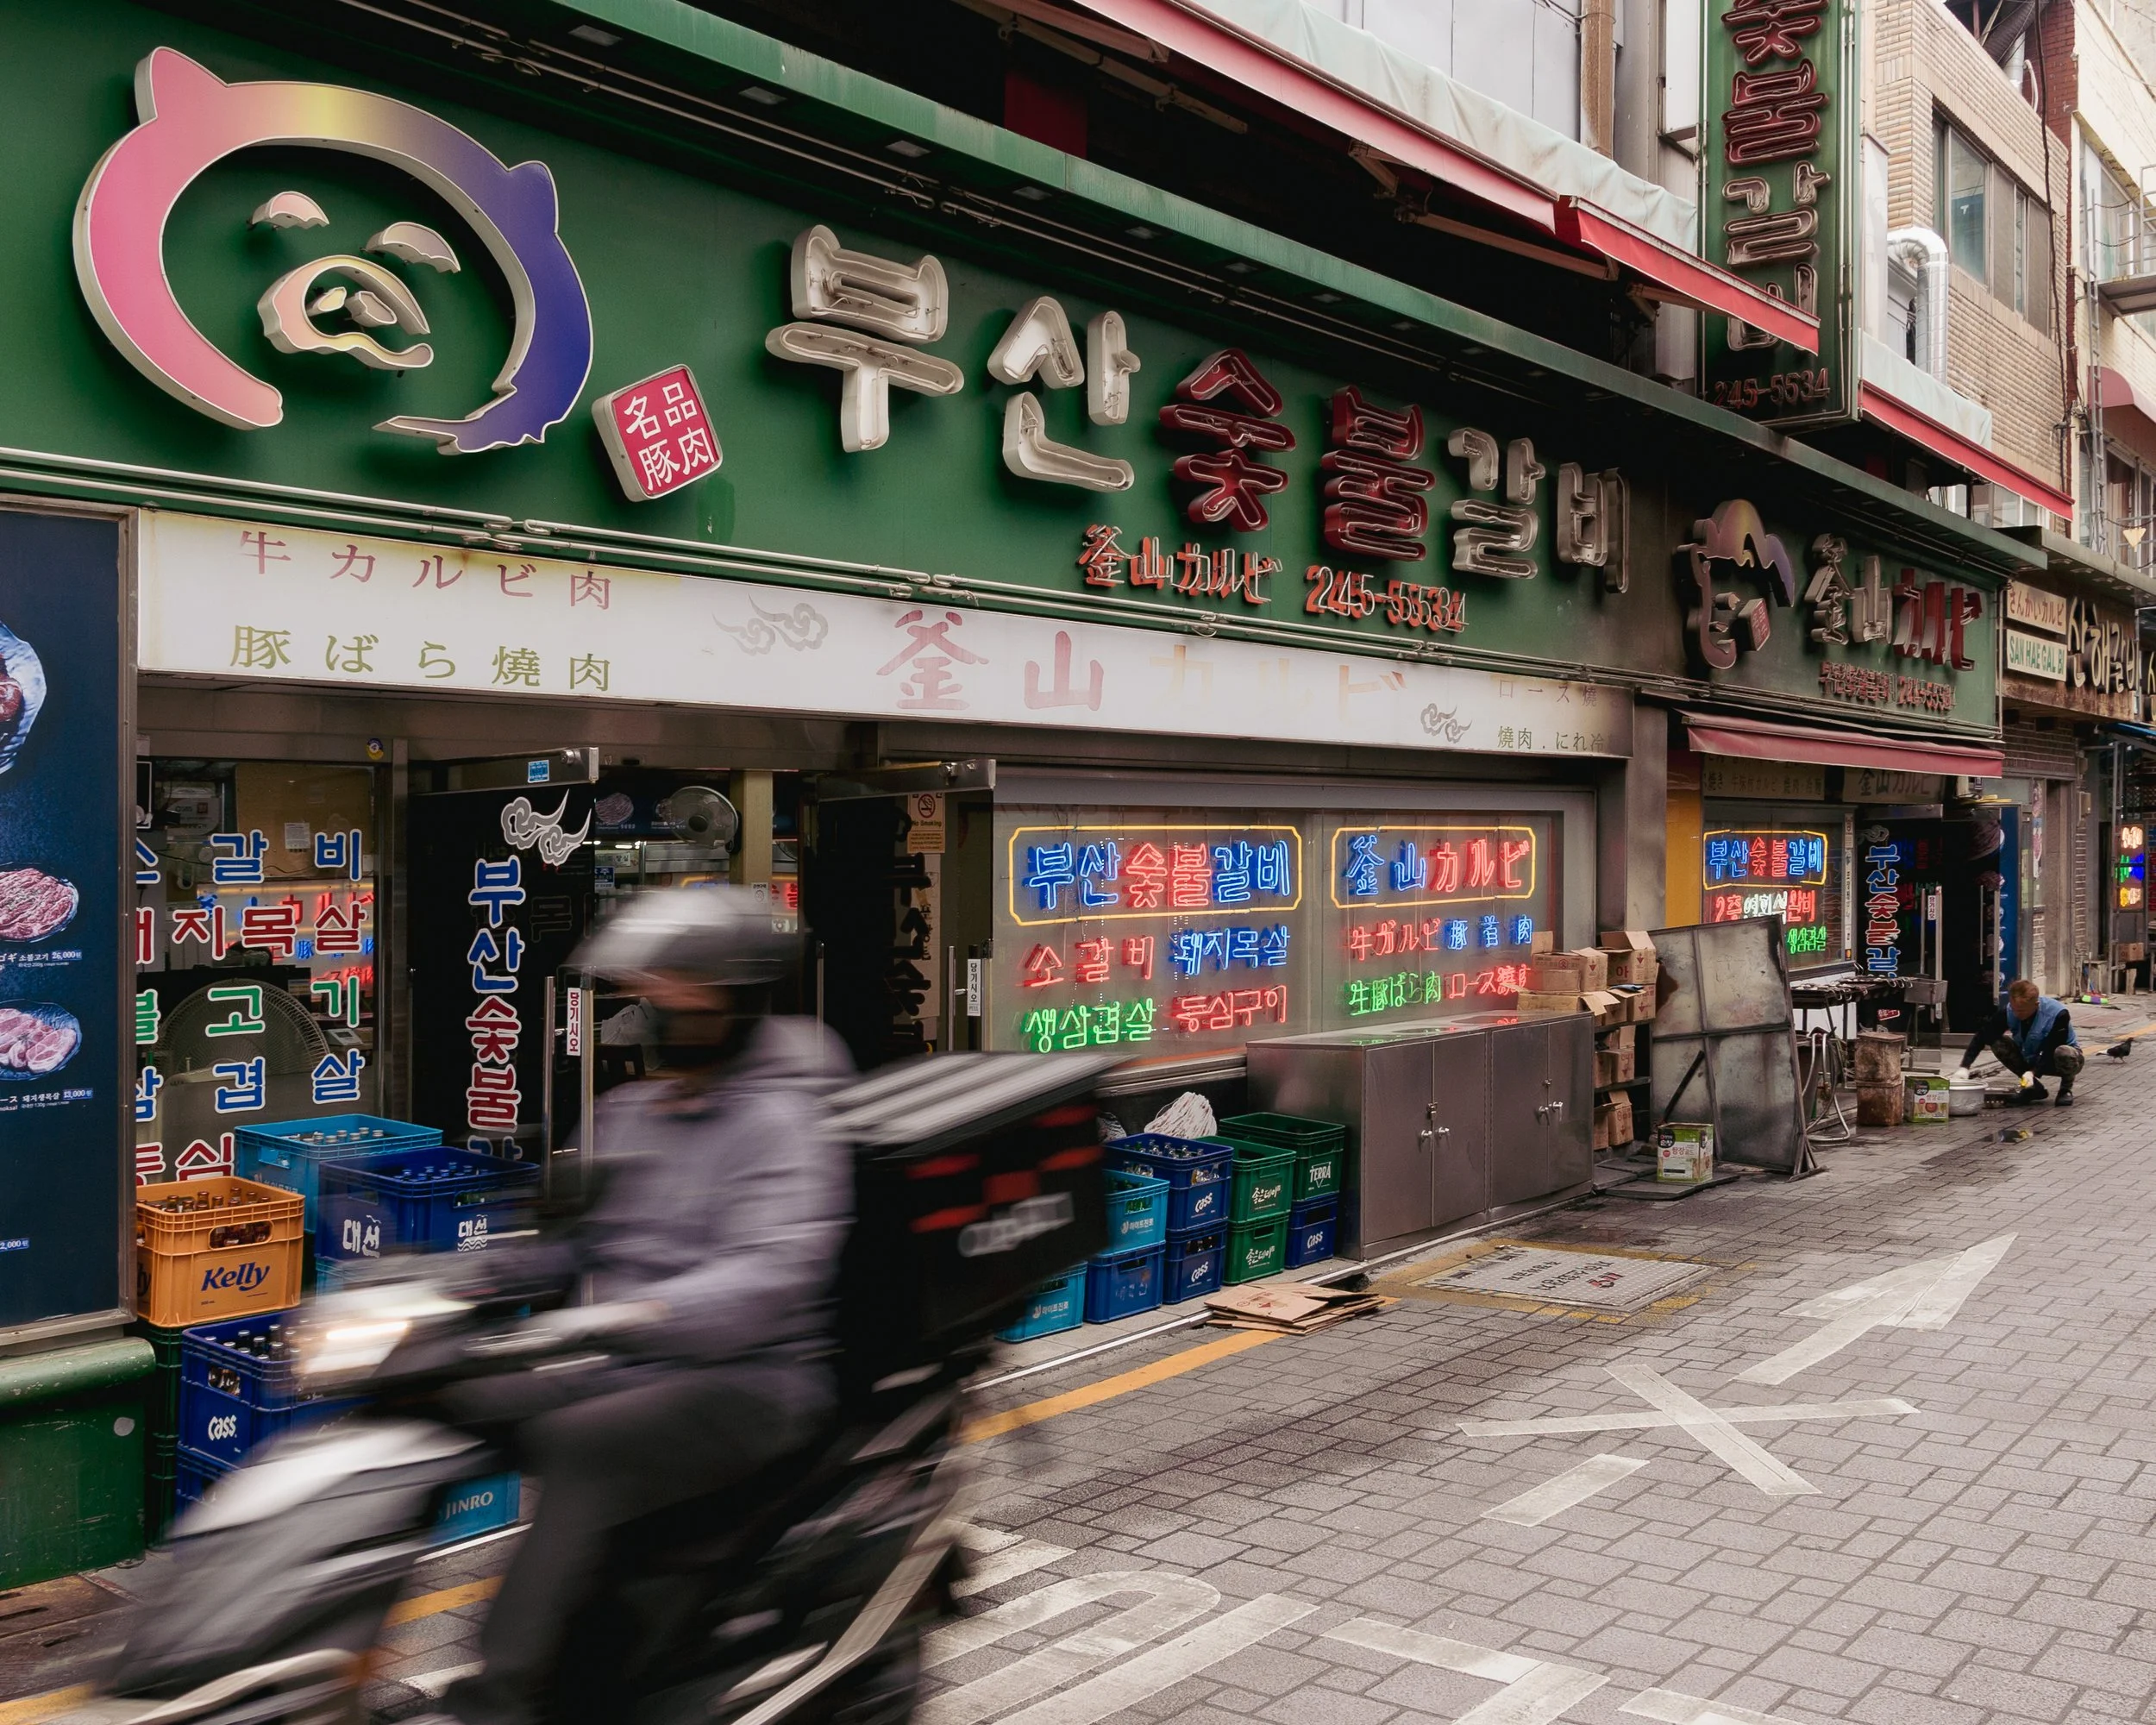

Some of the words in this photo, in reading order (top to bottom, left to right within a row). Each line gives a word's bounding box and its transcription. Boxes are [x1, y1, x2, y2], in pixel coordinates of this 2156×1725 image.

[624, 381, 699, 440] 名品
[766, 224, 1630, 594] 부산숯불갈비
[1714, 367, 1832, 409] 245-5534
[639, 427, 716, 492] 豚肉
[239, 530, 611, 611] 牛カルビ肉
[1079, 524, 1283, 604] 釜山カルビ
[1305, 565, 1470, 633] 245-5534
[2009, 636, 2024, 665] SAN
[2026, 640, 2040, 670] HAE
[2041, 643, 2057, 674] GAL
[2058, 649, 2065, 675] BI
[1025, 839, 1291, 910] 부산숯불갈비
[1344, 834, 1532, 896] 釜山カルビ
[1709, 837, 1822, 881] 부산숯불갈비
[1865, 844, 1901, 978] 부산숯불갈
[19, 953, 49, 962] 소불고기
[1024, 936, 1155, 988] 소갈비
[1171, 924, 1291, 976] 돼지목살
[1787, 925, 1827, 955] 생삼겹살
[969, 963, 978, 1002] 당기시오
[1348, 970, 1442, 1016] 生豚ばら肉
[568, 991, 580, 1052] 당기시오
[1024, 997, 1156, 1053] 생삼겹살
[1173, 985, 1288, 1033] 등심구이
[1310, 1163, 1332, 1183] TERRA
[343, 1218, 381, 1258] 대선
[457, 1218, 488, 1237] 대선
[200, 1262, 271, 1292] Kelly
[1042, 1301, 1069, 1314] 하이트진로
[446, 1490, 493, 1520] JINRO
